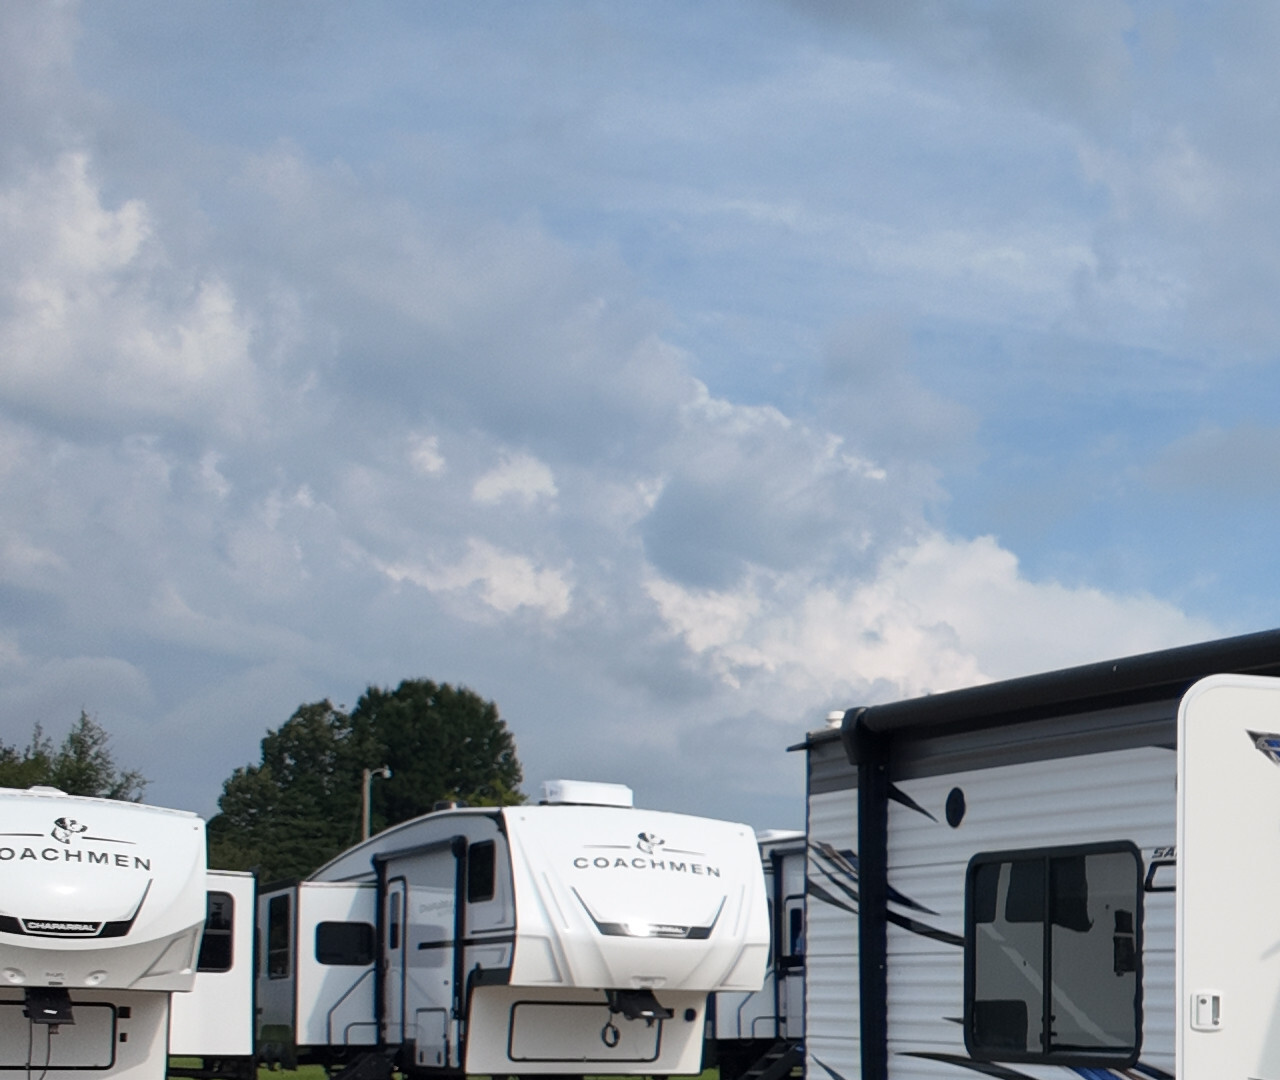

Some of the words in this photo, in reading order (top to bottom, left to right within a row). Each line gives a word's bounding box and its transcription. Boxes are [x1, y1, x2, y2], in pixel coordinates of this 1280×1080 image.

[0, 847, 151, 871] OACHMEN
[573, 856, 721, 878] COACHMEN
[26, 921, 96, 932] CHAPARRAL
